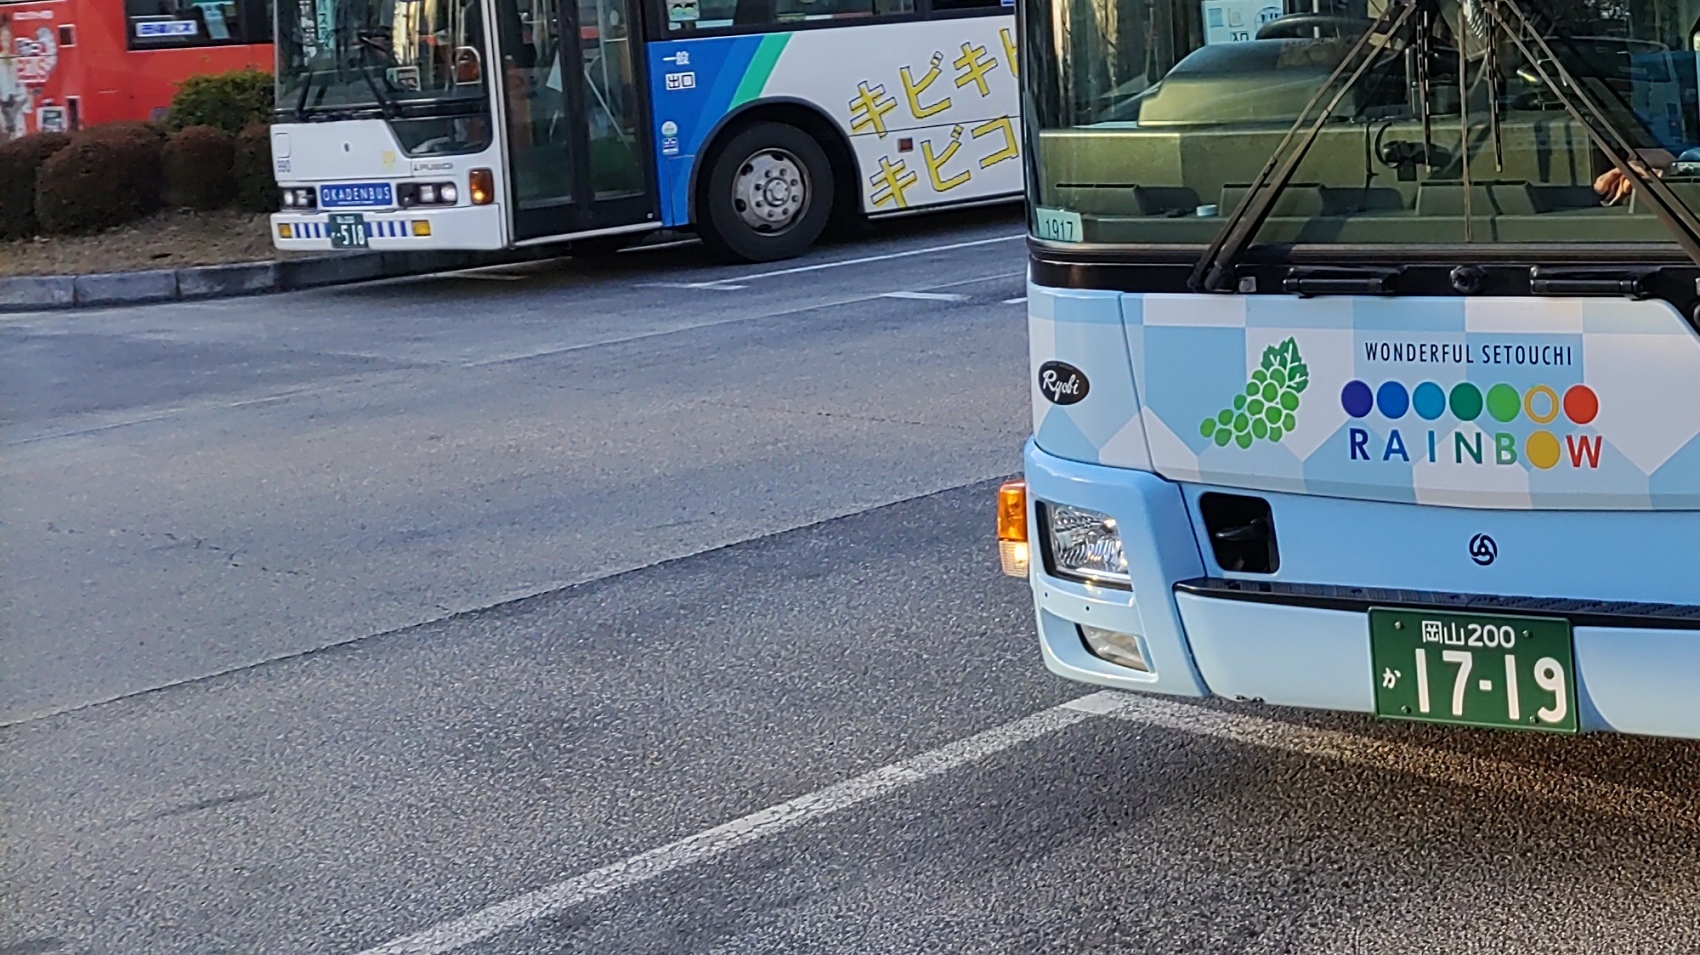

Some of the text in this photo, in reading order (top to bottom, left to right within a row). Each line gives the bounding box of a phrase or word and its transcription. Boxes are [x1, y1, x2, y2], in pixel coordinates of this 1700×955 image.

[667, 74, 694, 89] 出口
[322, 188, 390, 201] OKADENBUS
[1045, 218, 1074, 242] 1917
[1365, 342, 1572, 366] WONDERFUL SETOUCHI
[1042, 369, 1081, 402] Ryobi
[1349, 427, 1603, 470] RAINBOW
[1382, 648, 1567, 723] か 17-19
